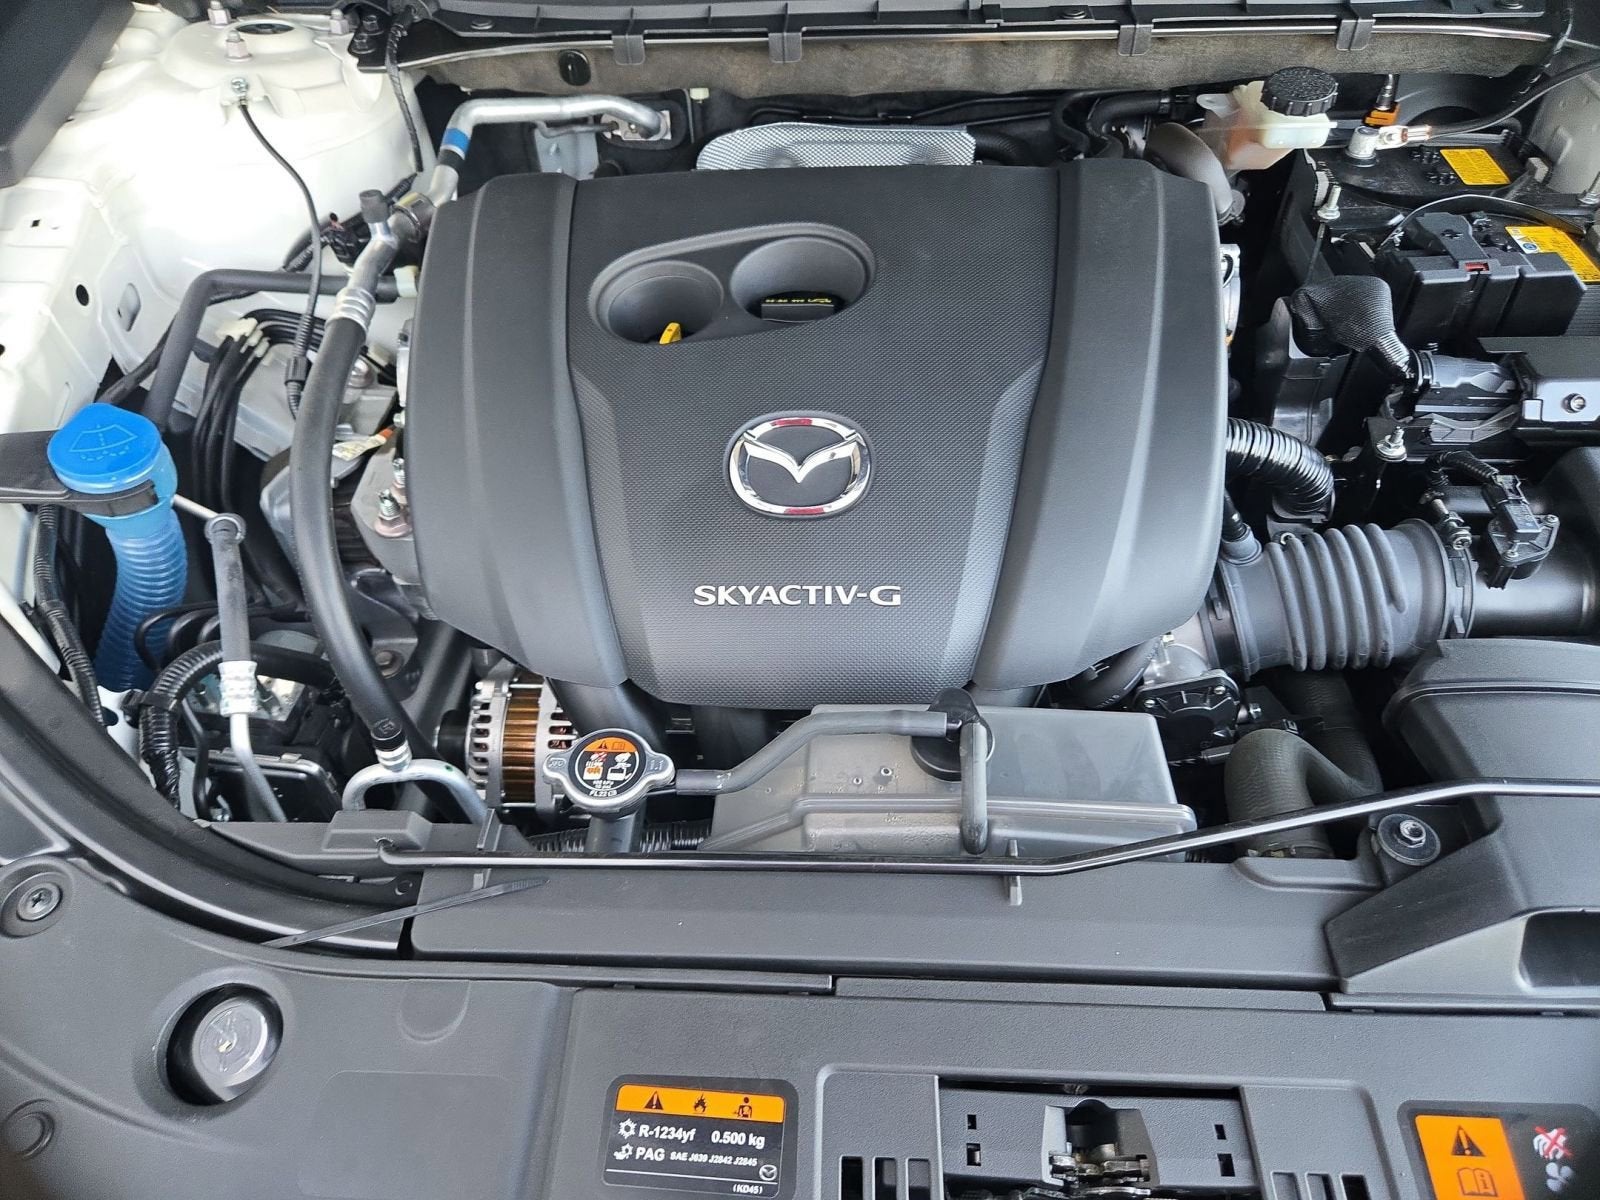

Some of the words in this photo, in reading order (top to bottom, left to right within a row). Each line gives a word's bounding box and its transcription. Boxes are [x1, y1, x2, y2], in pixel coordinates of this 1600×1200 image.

[693, 585, 902, 606] SKYACTIV-G
[638, 1123, 696, 1143] R-1234yf
[711, 1131, 746, 1145] 0.500
[748, 1133, 766, 1149] kg
[635, 1147, 665, 1161] PAG
[670, 1151, 688, 1161] SAE
